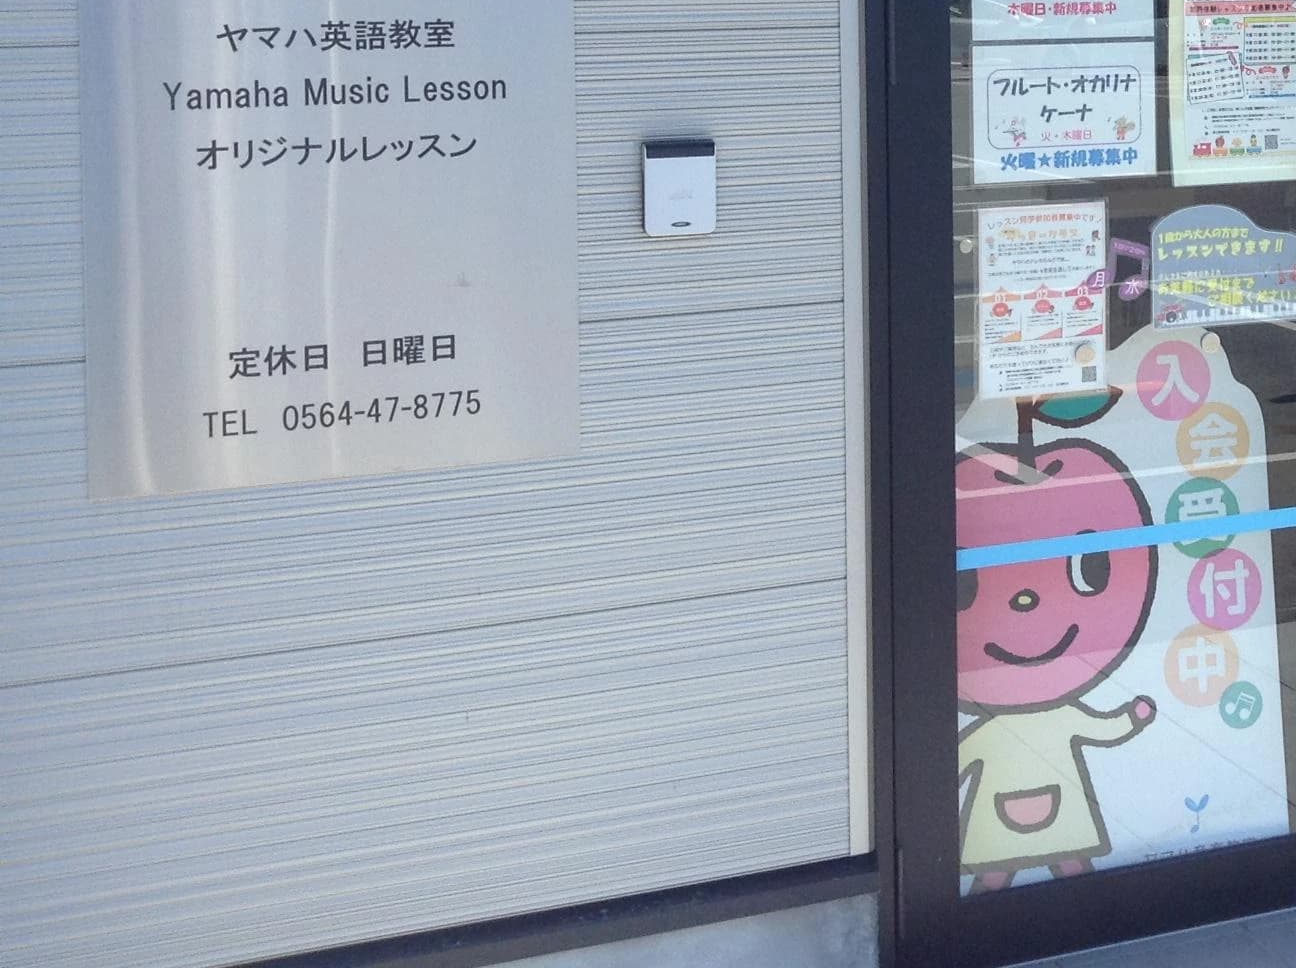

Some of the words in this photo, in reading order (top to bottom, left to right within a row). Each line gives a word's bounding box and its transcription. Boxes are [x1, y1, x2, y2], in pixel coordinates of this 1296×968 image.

[215, 19, 456, 54] ヤマハ英語教室
[163, 79, 290, 113] Yamaha
[303, 75, 390, 106] Music
[403, 75, 508, 104] Lesson
[992, 73, 1137, 97] フルート・オカリナ
[1040, 103, 1093, 123] ケーナ
[195, 133, 478, 171] オリジナルレッスン
[1077, 286, 1089, 296] 03
[1092, 271, 1106, 288] 月
[228, 342, 329, 380] 定休日
[361, 334, 458, 369] 日曜日
[202, 408, 258, 439] TEL
[281, 388, 482, 433] 0564-47-8775
